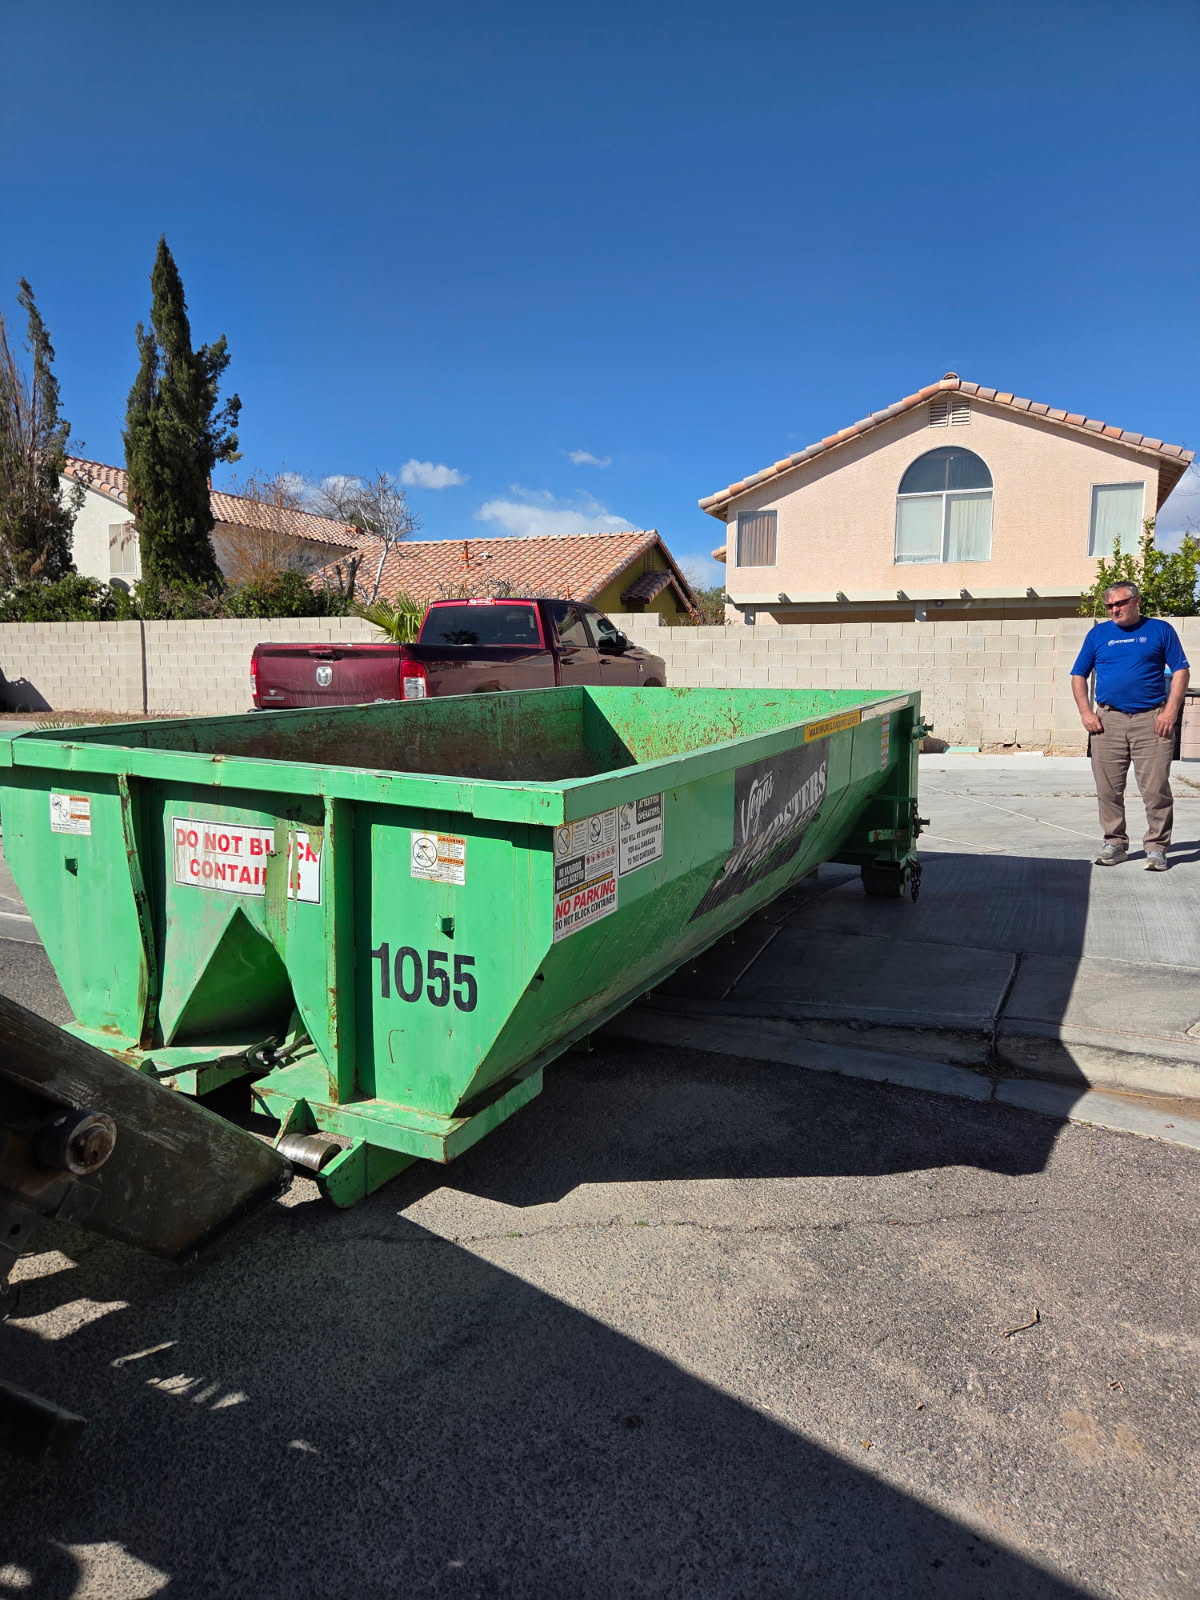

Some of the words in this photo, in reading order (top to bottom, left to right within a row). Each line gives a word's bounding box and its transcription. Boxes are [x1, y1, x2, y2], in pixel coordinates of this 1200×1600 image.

[741, 770, 774, 844] Vegas
[176, 828, 199, 848] DO
[204, 832, 243, 854] NOT
[555, 899, 571, 921] NO
[573, 878, 616, 912] PARKING
[555, 919, 563, 932] DO
[563, 914, 574, 928] NOT
[574, 906, 591, 922] BLOCK
[590, 893, 616, 915] CONTAINER
[370, 942, 478, 1012] 1055
